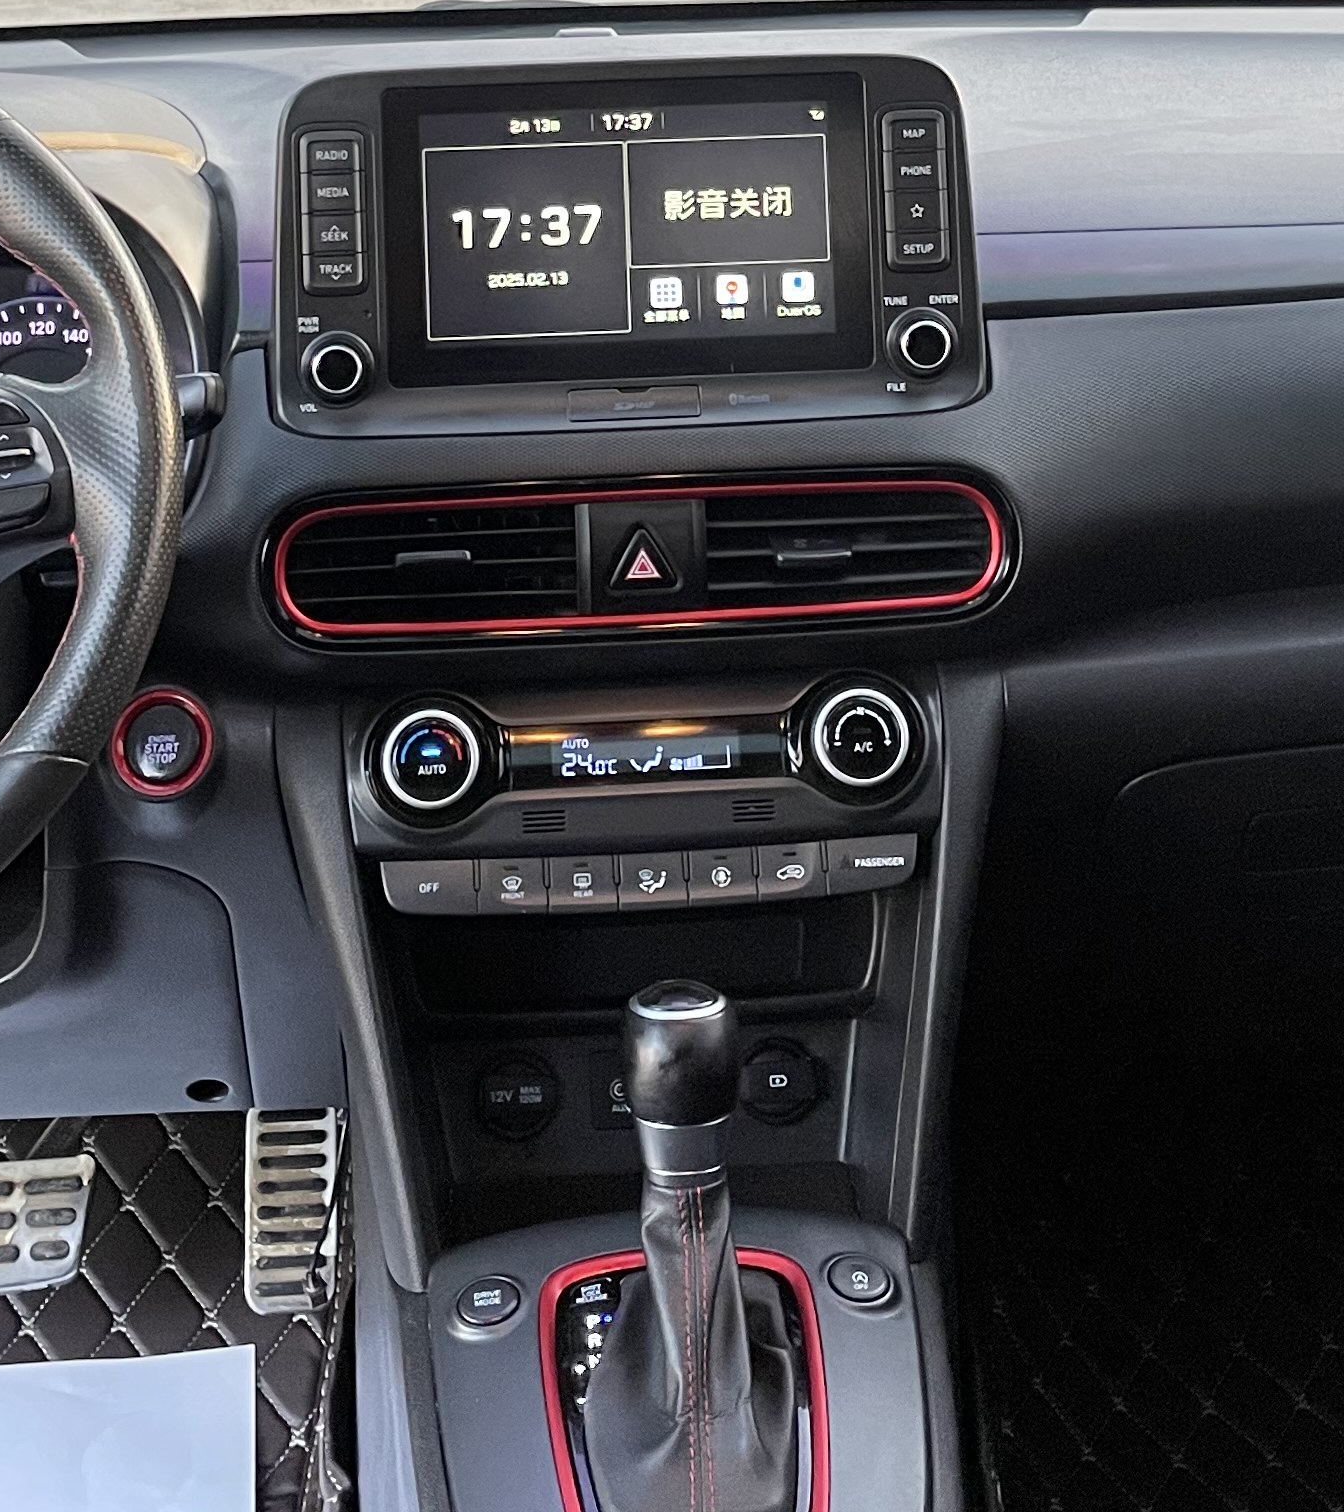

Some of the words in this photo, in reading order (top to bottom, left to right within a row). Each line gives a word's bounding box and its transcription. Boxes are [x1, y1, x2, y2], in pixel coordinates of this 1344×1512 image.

[601, 112, 653, 131] 17:37
[902, 128, 926, 139] MAP
[315, 150, 349, 161] RADIO
[900, 165, 932, 176] PHONE
[316, 187, 350, 199] MEDIA
[663, 186, 792, 222] 影音关闭
[451, 203, 603, 250] 17:37
[320, 229, 349, 242] SEEK
[902, 243, 935, 255] SETUP
[319, 263, 353, 275] TRACK
[487, 271, 569, 289] 2025.02.13
[883, 296, 908, 307] TUNE
[928, 294, 959, 305] ENTER
[29, 320, 56, 336] 120
[297, 317, 320, 327] PWR
[62, 329, 89, 343] 140
[886, 382, 907, 393] FILE
[299, 403, 318, 414] VOL
[144, 742, 180, 754] START
[561, 738, 589, 750] AUTO
[853, 741, 874, 754] A/C
[147, 753, 176, 764] STOP
[417, 763, 447, 776] AUTO
[854, 856, 905, 868] PASSENGER
[418, 882, 440, 894] OFF
[490, 1090, 513, 1103] 12V
[473, 1289, 502, 1300] DRIVE
[474, 1297, 502, 1307] MODE
